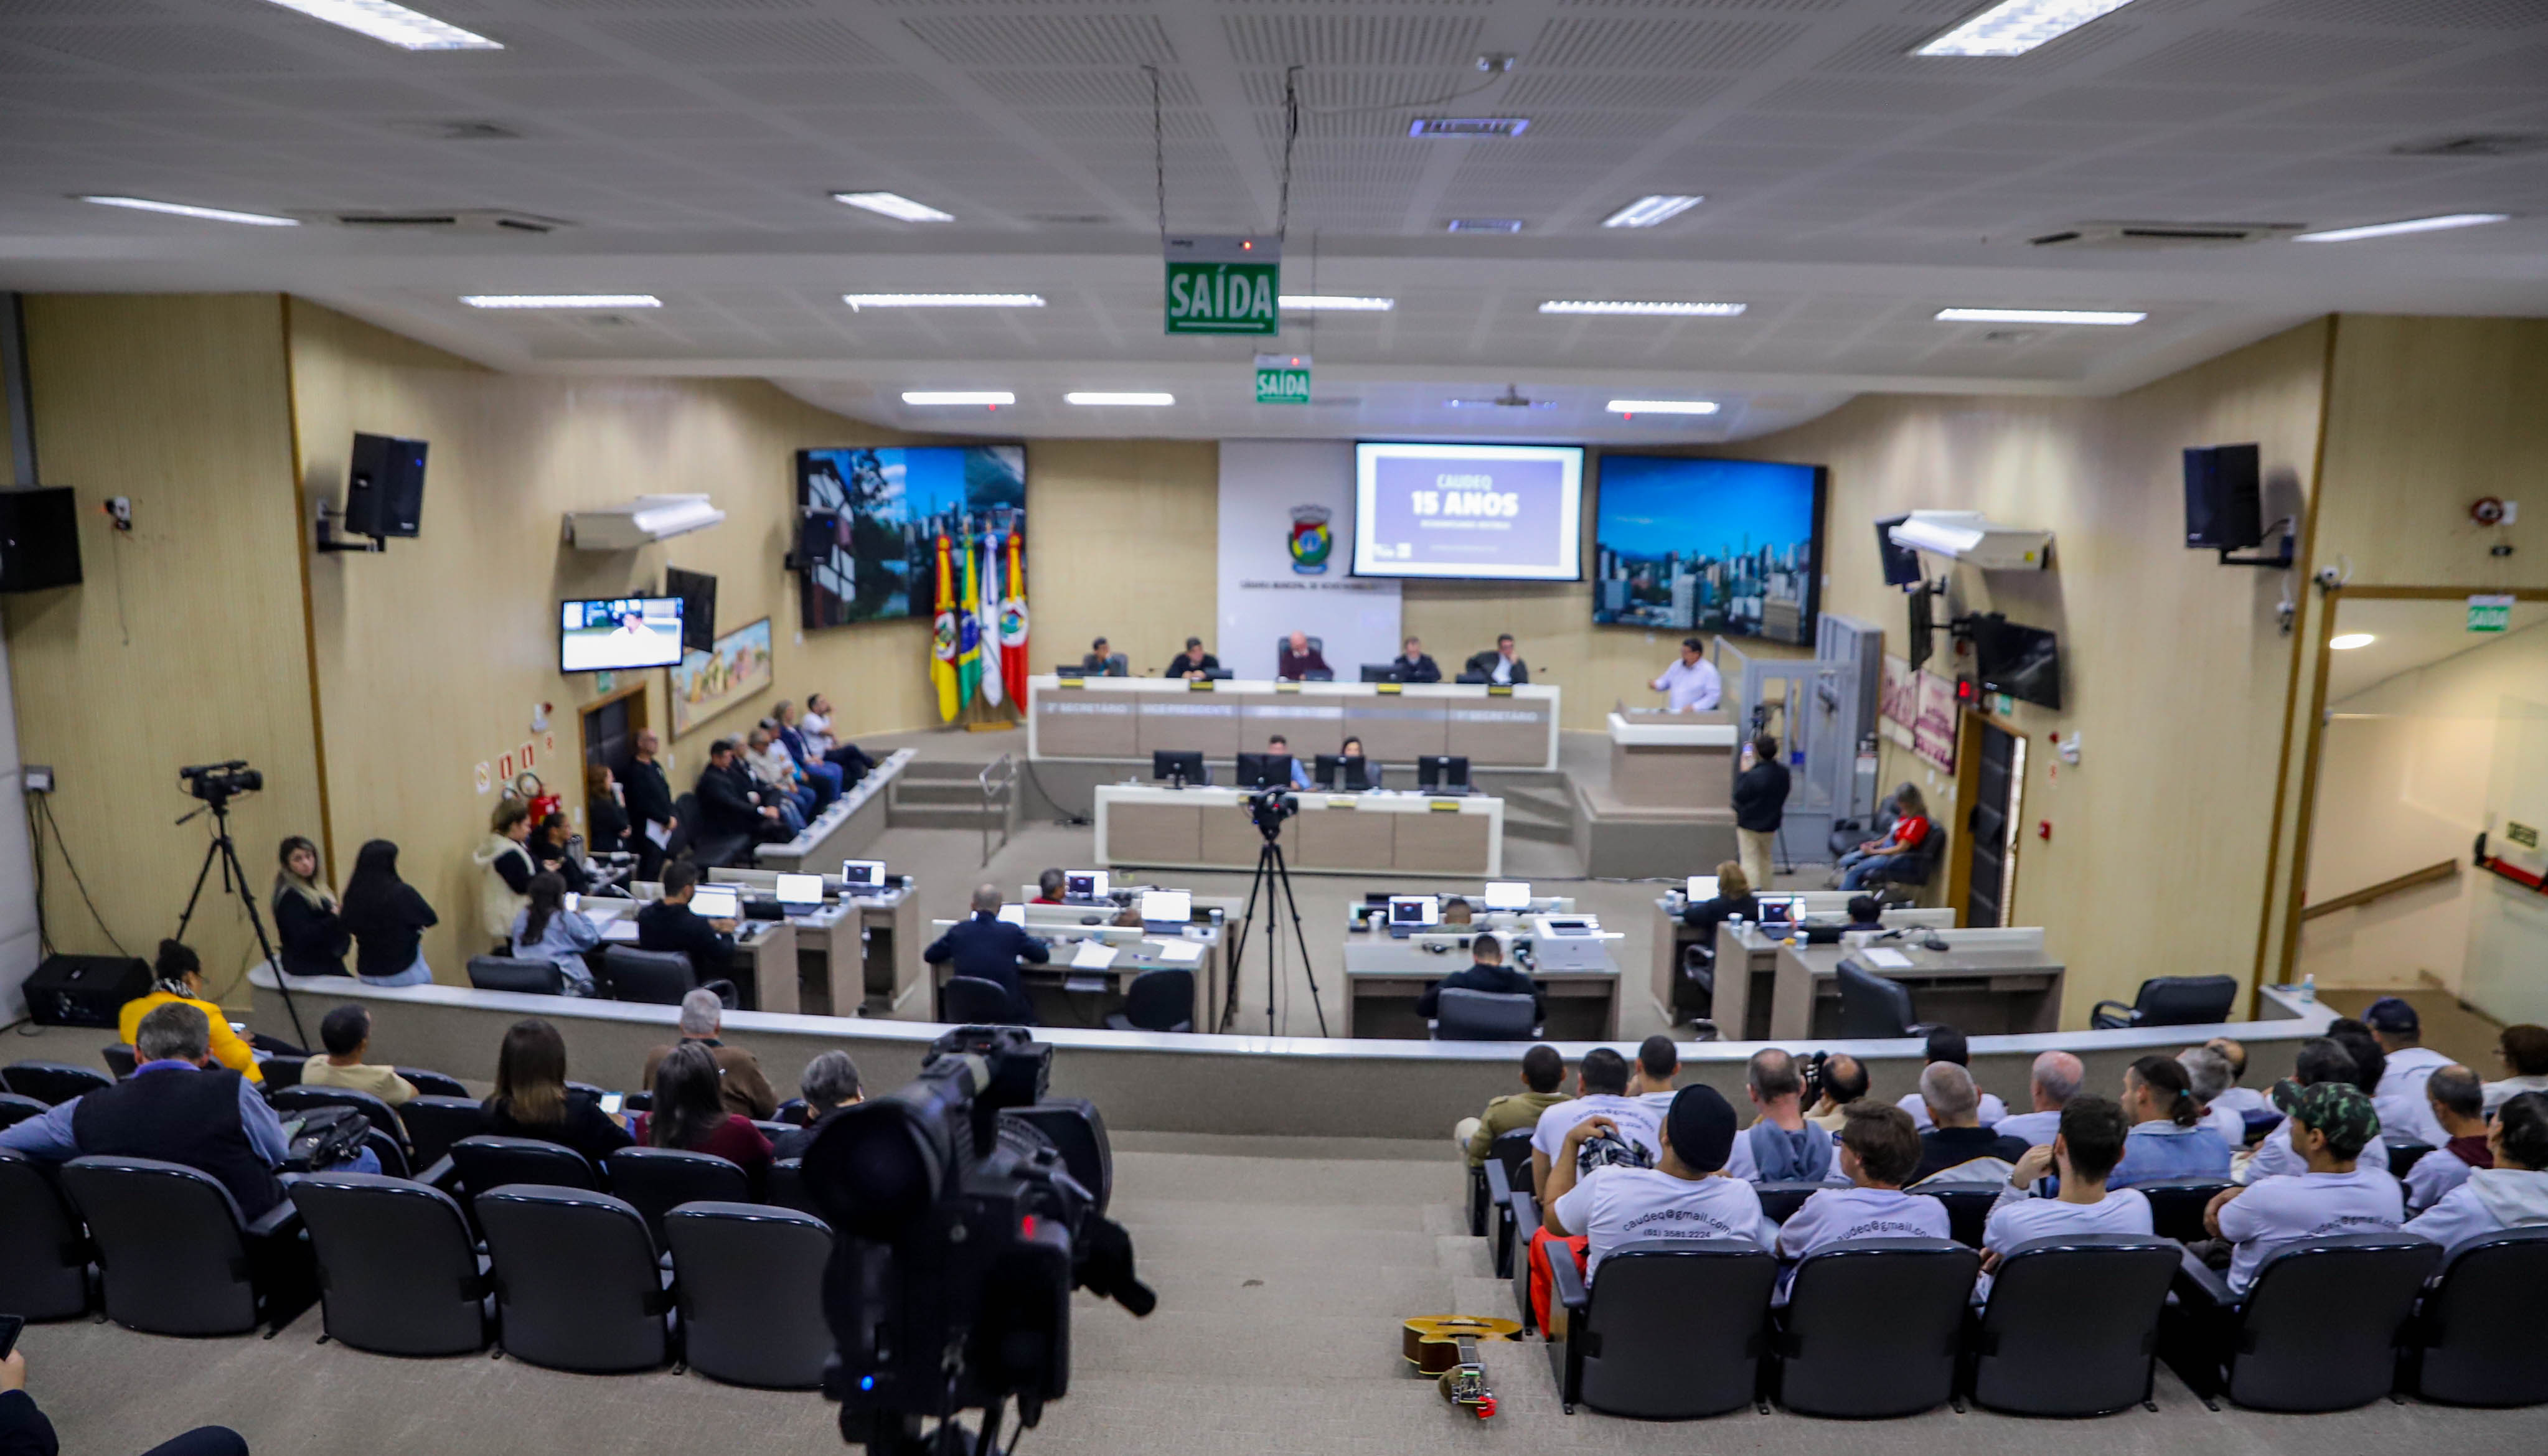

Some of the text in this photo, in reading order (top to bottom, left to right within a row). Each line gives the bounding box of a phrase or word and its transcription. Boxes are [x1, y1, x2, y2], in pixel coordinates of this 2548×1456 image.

[1170, 264, 1273, 319] SAÍDA
[1258, 370, 1307, 395] SAÍDA
[1437, 474, 1493, 491] CAUDEQ
[1411, 491, 1519, 517] 15 ANOS
[2469, 608, 2507, 626] SAÍDA
[1623, 1209, 1731, 1235] caudeq@gmail.com
